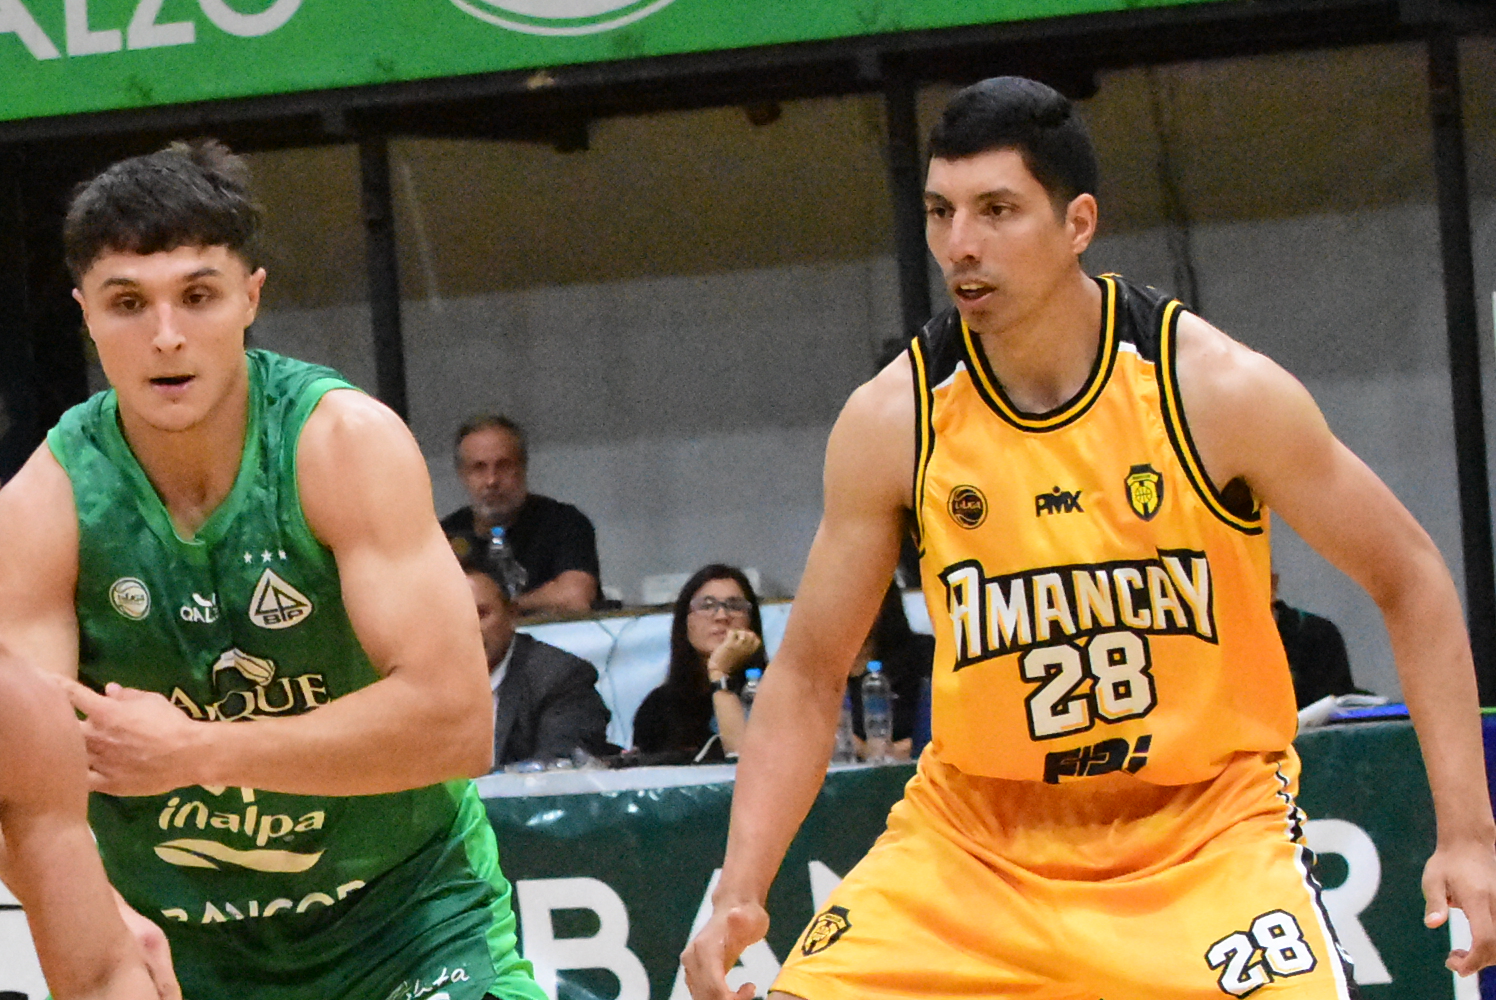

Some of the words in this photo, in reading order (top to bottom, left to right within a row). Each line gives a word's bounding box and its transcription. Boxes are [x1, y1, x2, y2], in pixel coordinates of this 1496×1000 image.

[938, 546, 1219, 671] AMANCAY
[1018, 631, 1157, 741] 28
[1204, 909, 1318, 1000] 28
